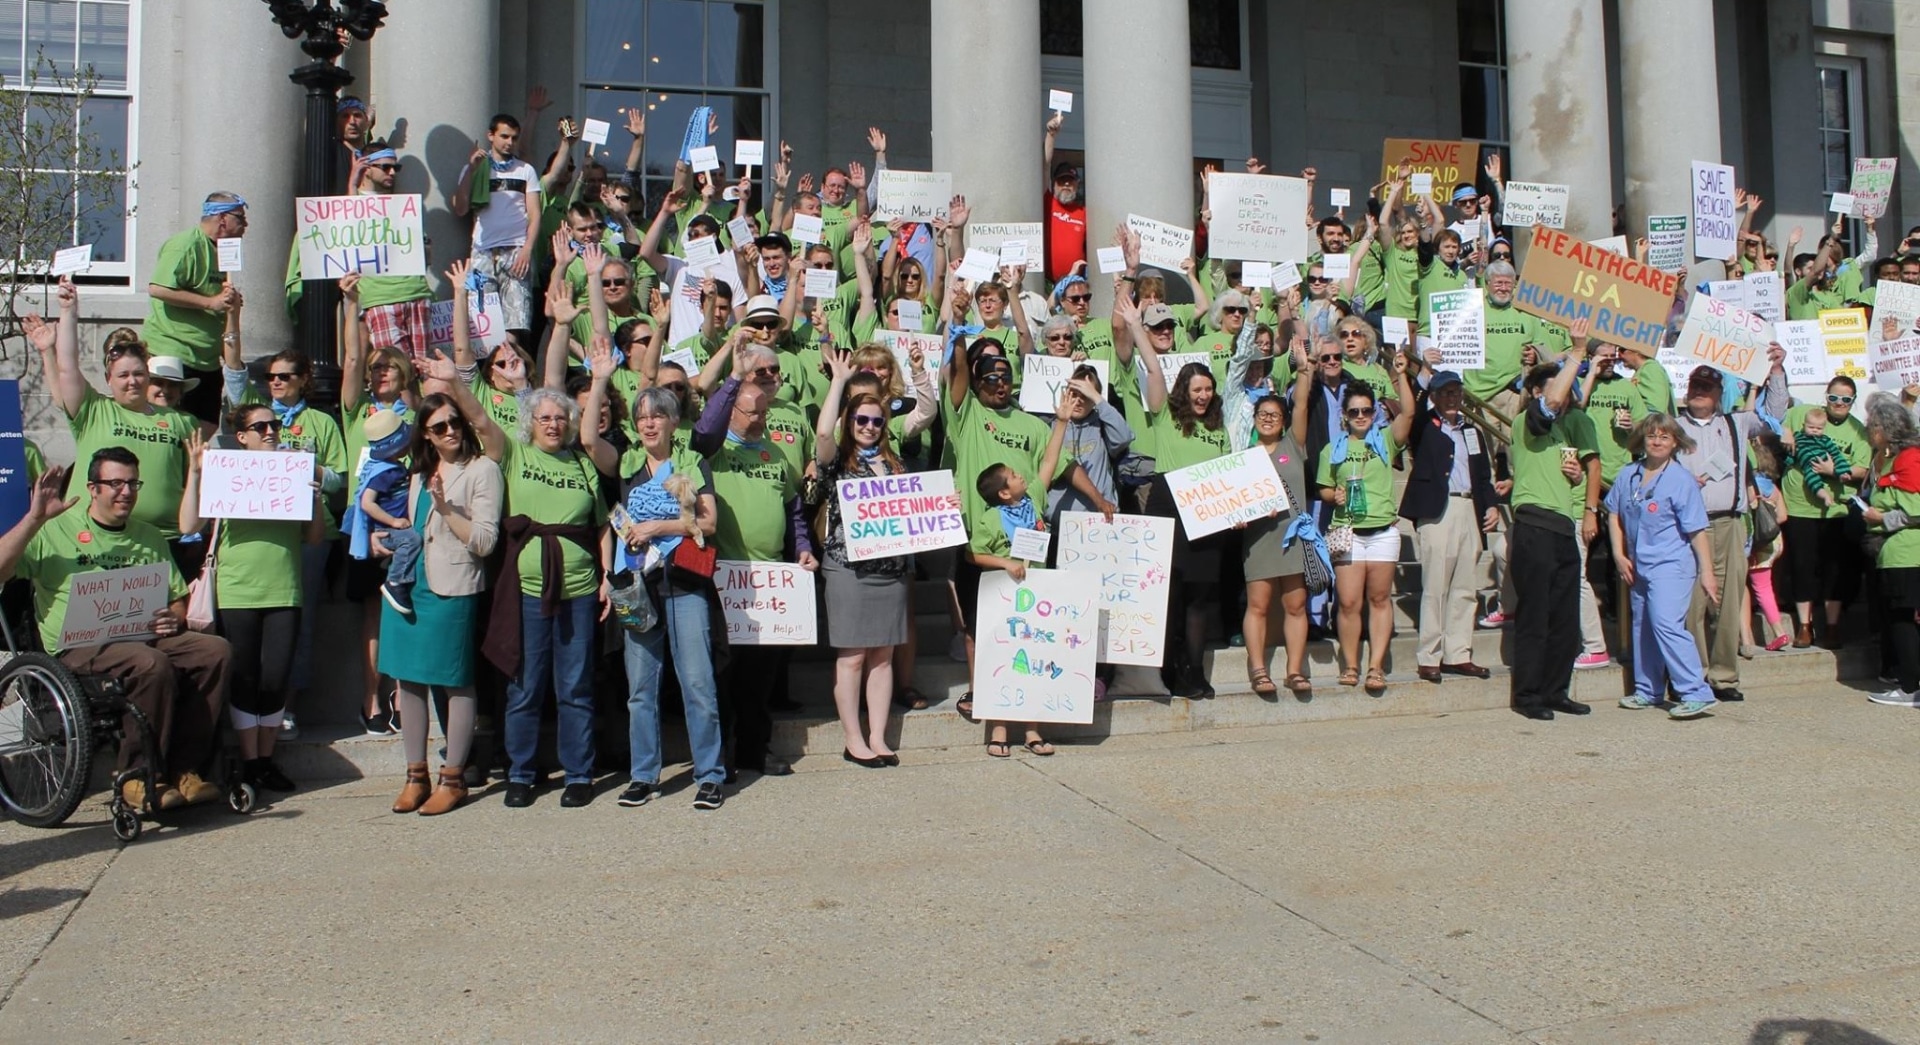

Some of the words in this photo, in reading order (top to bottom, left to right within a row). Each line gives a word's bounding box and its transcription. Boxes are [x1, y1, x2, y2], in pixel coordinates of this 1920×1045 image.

[1408, 142, 1461, 164] SAVE
[1509, 183, 1541, 192] MENTAL
[1699, 169, 1726, 194] SAVE
[304, 196, 392, 223] SUPPORT
[402, 196, 417, 218] A
[878, 203, 904, 216] Need
[911, 204, 931, 218] Med
[1239, 196, 1269, 207] HEALTH
[1507, 202, 1534, 211] OPIOID
[1697, 195, 1733, 218] MEDICAID
[1238, 209, 1278, 222] GROWTH
[1506, 211, 1534, 223] NEED
[303, 217, 412, 255] healthy
[972, 225, 1011, 236] MENTAL
[1130, 218, 1157, 230] WHAT
[1162, 227, 1190, 241] WOULD
[1237, 223, 1287, 236] STRENGTH
[1695, 217, 1735, 241] EXPANSION
[324, 245, 388, 278] NH!
[1533, 226, 1677, 297] HEALTHCARE
[1573, 270, 1598, 297] IS
[1600, 283, 1620, 309] A
[1752, 276, 1771, 285] VOTE
[1756, 289, 1768, 297] NO
[1517, 280, 1593, 320] HUMAN
[1595, 307, 1665, 347] RIGHT
[1708, 299, 1725, 317] SB
[1733, 309, 1763, 333] 313
[1826, 317, 1858, 326] OPPOSE
[1701, 316, 1757, 348] SAVES
[1789, 325, 1805, 334] WE
[884, 335, 946, 352] #MDEX
[1786, 337, 1812, 346] VOTE
[1890, 341, 1911, 353] VOTER
[1693, 333, 1757, 375] LIVES!
[1794, 355, 1809, 363] WE
[1791, 367, 1815, 376] CARE
[1851, 369, 1866, 378] 569
[1875, 356, 1912, 373] COMMITTEE
[1901, 373, 1910, 385] TO
[113, 428, 177, 446] #MedEx
[207, 454, 277, 471] MEDICAID
[1187, 452, 1247, 482] SUPPORT
[231, 475, 292, 493] SAVED
[522, 470, 586, 492] #MedEx
[842, 475, 923, 502] CANCER
[1176, 478, 1234, 508] SMALL
[1194, 478, 1277, 522] BUSINESS
[210, 499, 237, 513] MY
[248, 496, 295, 513] LIFE
[857, 495, 960, 521] SCREENINGS
[850, 517, 904, 540] SAVE
[907, 513, 962, 536] LIVES
[1225, 510, 1242, 526] YES
[77, 578, 114, 596] WHAT
[122, 573, 161, 592] WOULD
[1102, 573, 1140, 588] KE
[93, 599, 121, 618] YOU
[128, 597, 145, 611] DO
[64, 627, 105, 643] WITHOUT
[994, 684, 1025, 708] SB
[1043, 693, 1075, 712] 313
